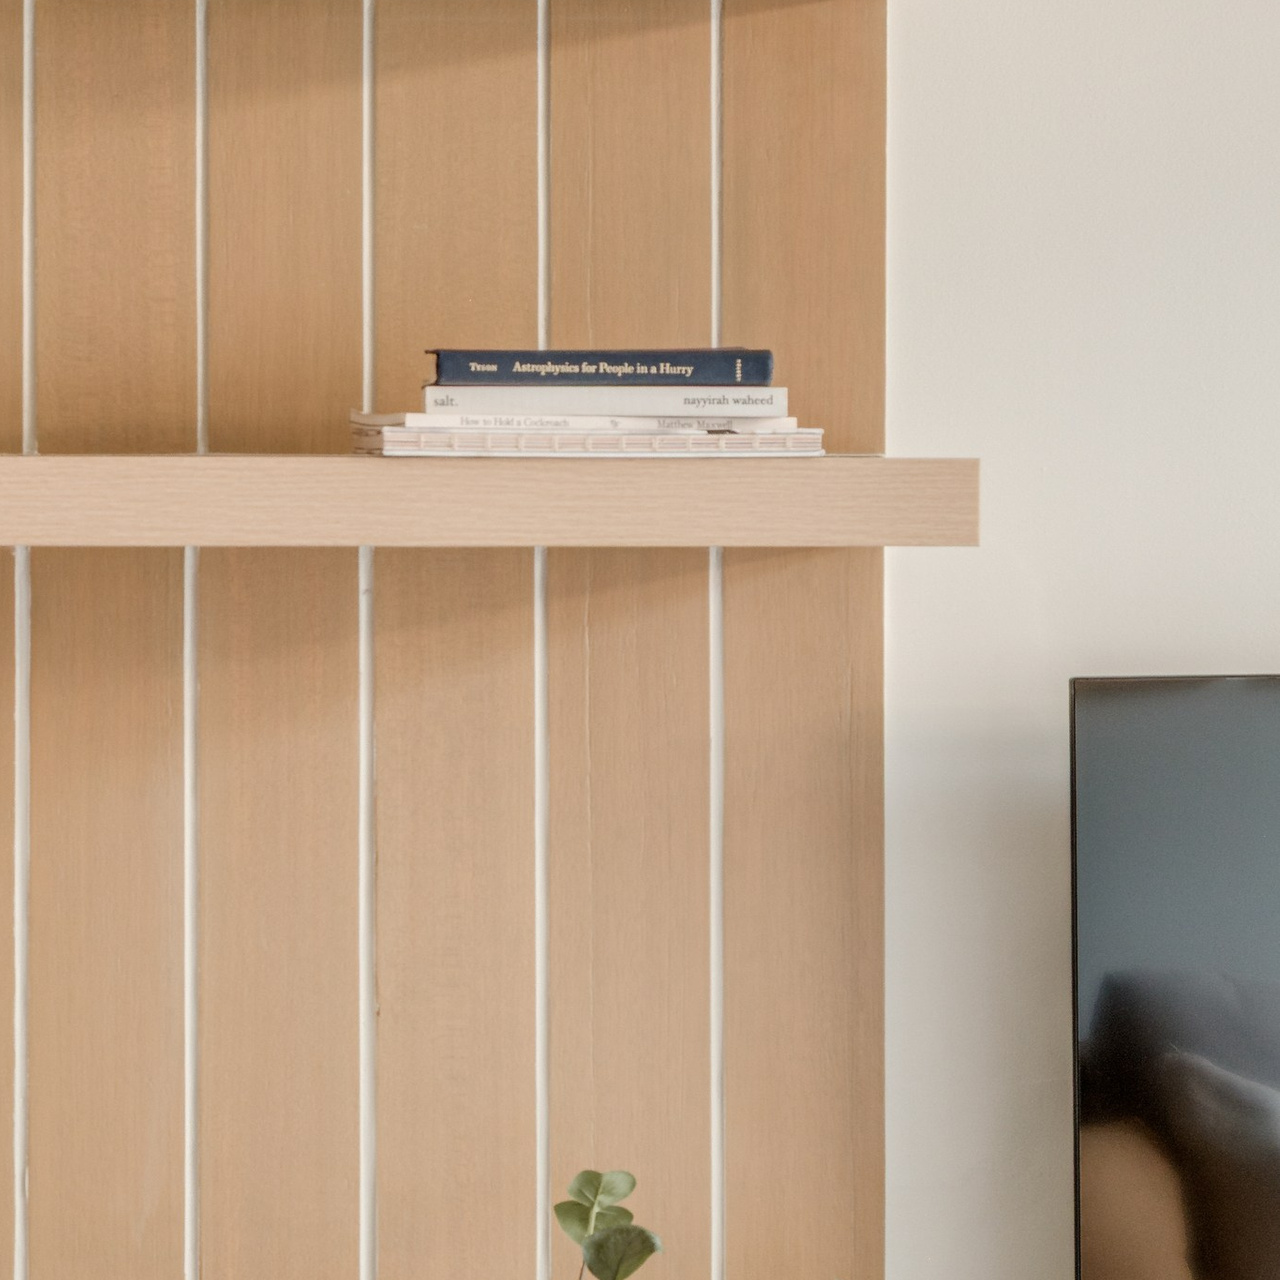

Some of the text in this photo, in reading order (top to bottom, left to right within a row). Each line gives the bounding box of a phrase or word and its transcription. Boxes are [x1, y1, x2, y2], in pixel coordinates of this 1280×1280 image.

[512, 361, 694, 377] Astrophysics for People in a Hurry
[433, 395, 459, 407] salt.
[683, 395, 774, 408] nayyirah waheed
[460, 416, 480, 426] How
[483, 417, 493, 426] to
[493, 417, 515, 427] Hold
[523, 417, 570, 427] Cockroach
[657, 419, 733, 430] Matthew Maxwell
